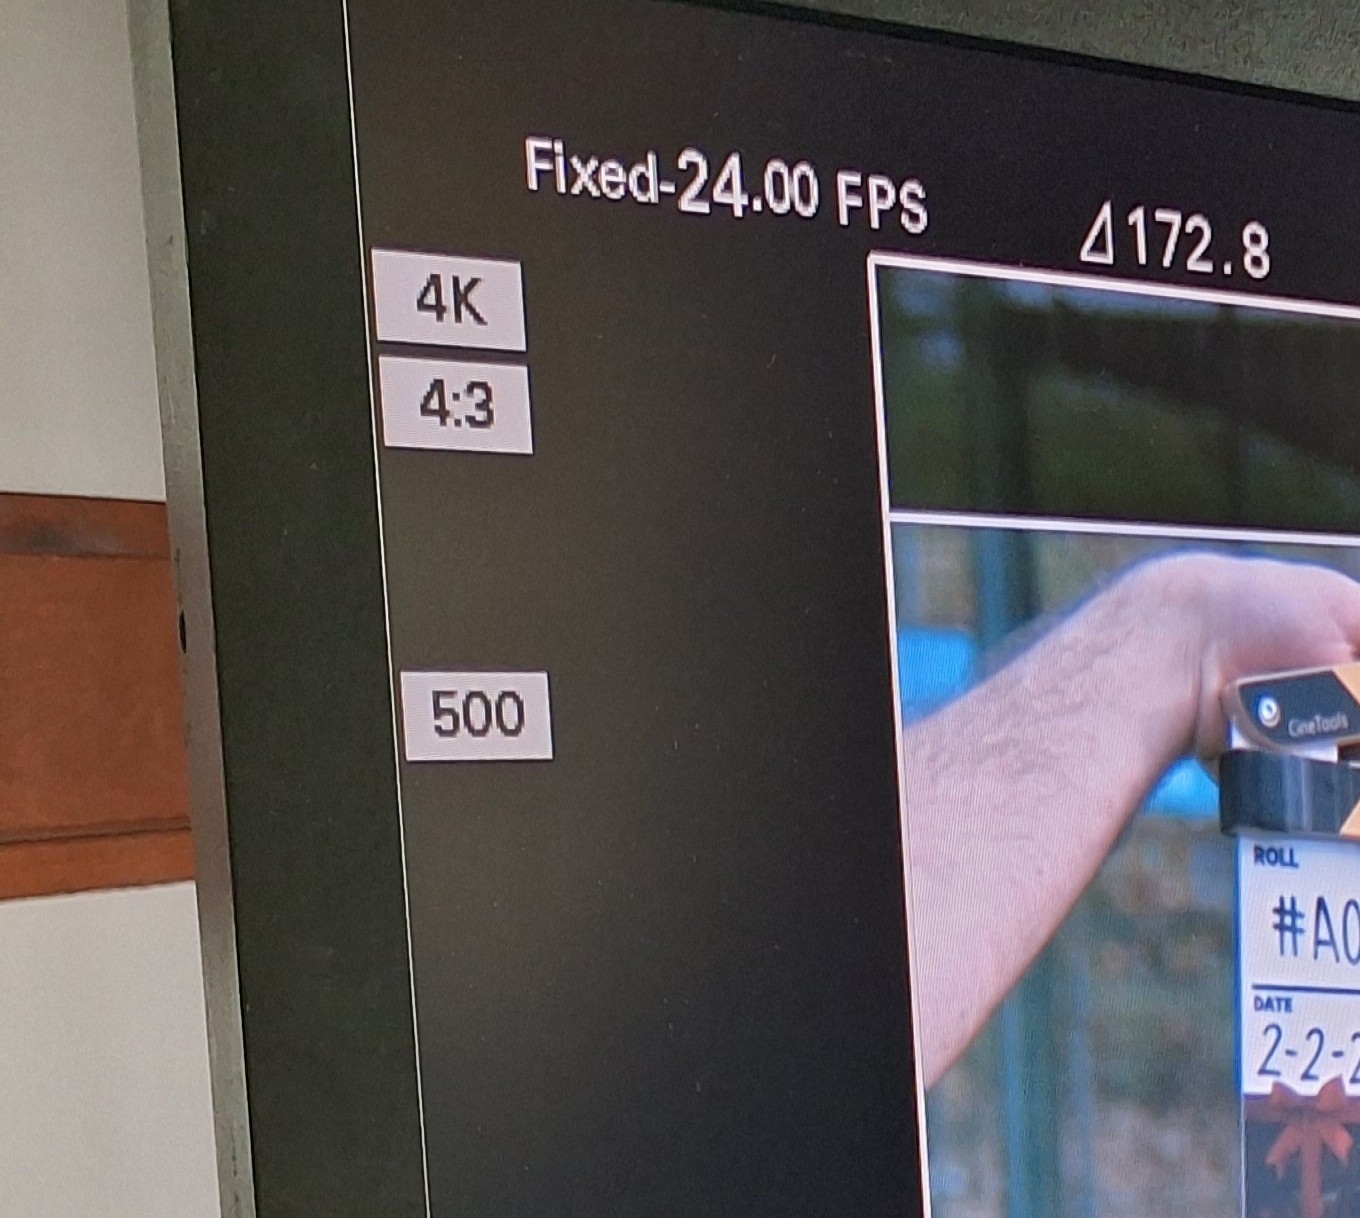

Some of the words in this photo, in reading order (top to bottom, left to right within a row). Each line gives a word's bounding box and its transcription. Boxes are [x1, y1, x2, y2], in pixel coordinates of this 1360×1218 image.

[525, 136, 820, 218] Fixed-24.00
[837, 171, 928, 233] FPS
[416, 274, 487, 326] 4K
[419, 380, 494, 429] 4:3
[431, 690, 526, 738] 500
[1254, 845, 1299, 868] ROLL
[1253, 996, 1293, 1014] DATE
